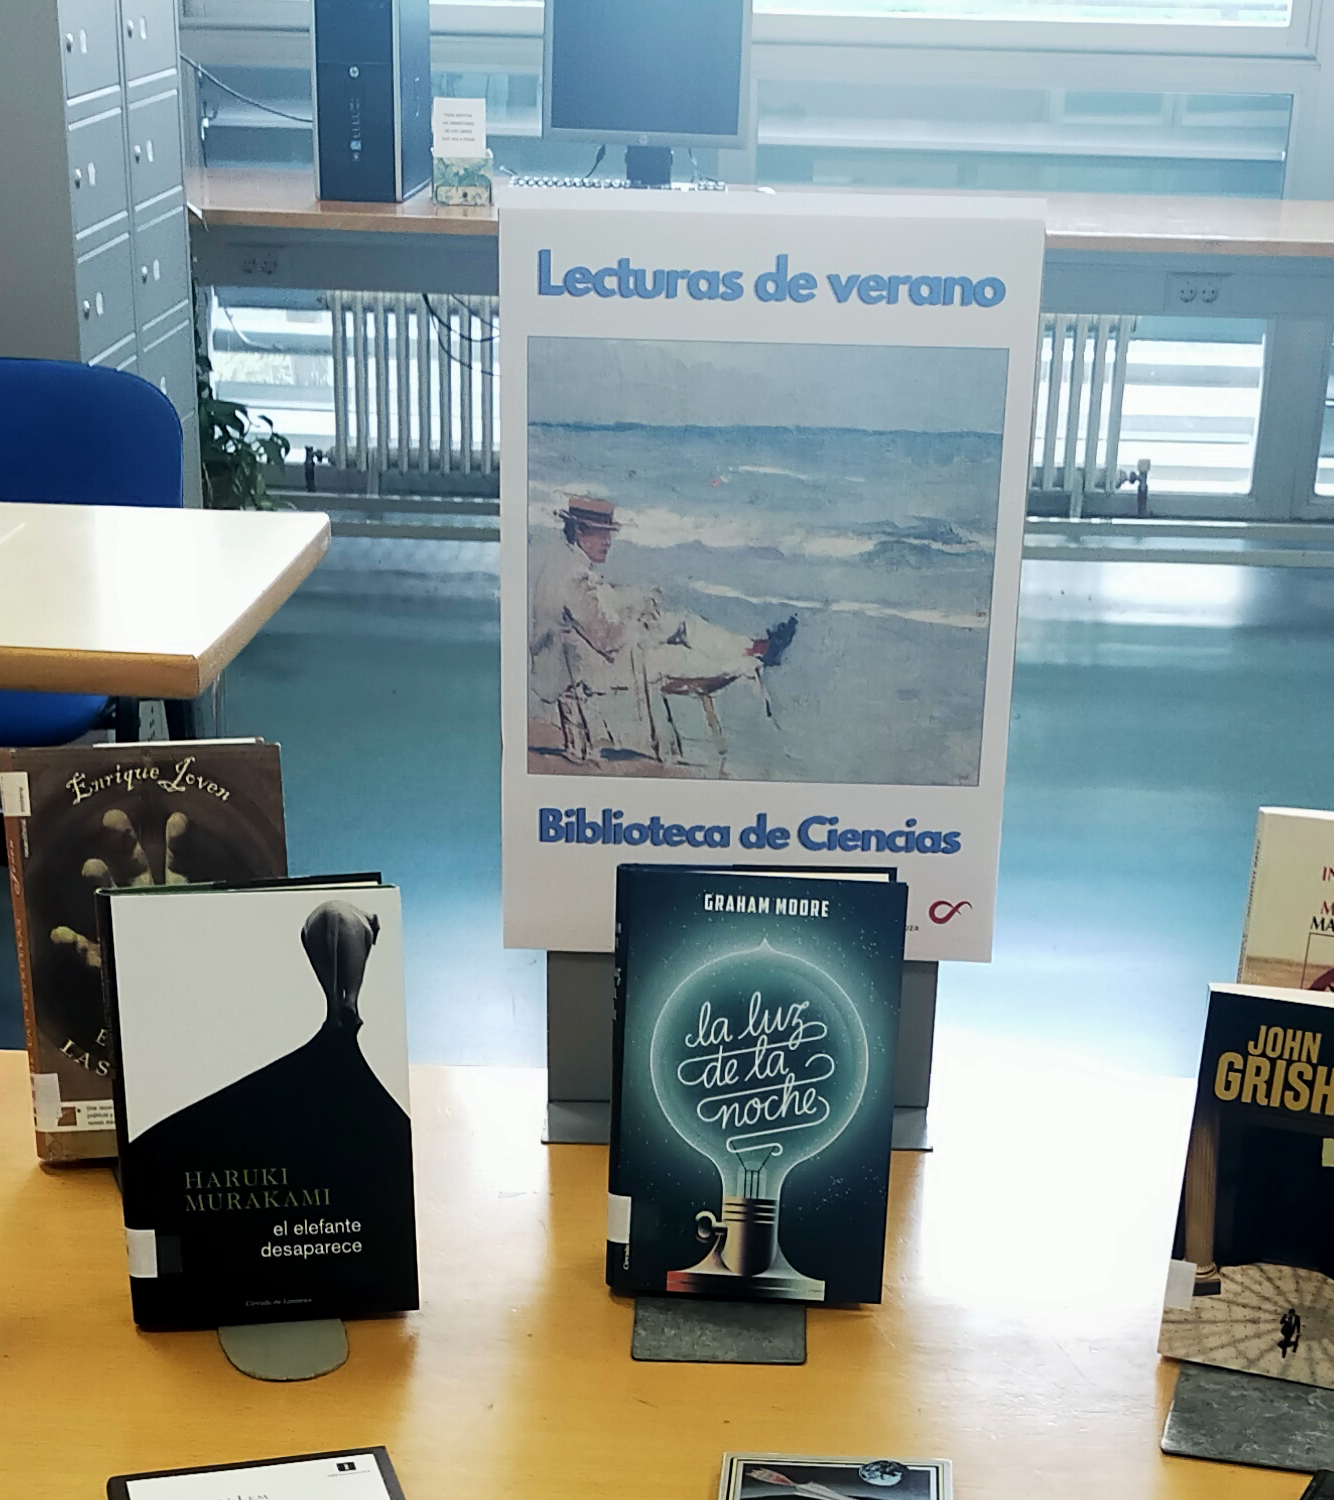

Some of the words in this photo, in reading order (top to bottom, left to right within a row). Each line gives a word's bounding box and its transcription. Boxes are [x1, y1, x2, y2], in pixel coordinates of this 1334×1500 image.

[537, 248, 744, 302] Lecturas
[753, 254, 817, 303] de
[827, 272, 1006, 308] verano
[65, 764, 160, 805] Enrique
[538, 806, 731, 850] Biblioteca
[739, 812, 790, 853] de
[796, 814, 962, 856] Ciencias
[704, 893, 769, 914] GRAHAM
[776, 896, 829, 918] MOORE
[685, 1000, 733, 1048] la
[737, 990, 815, 1048] luz
[701, 1044, 739, 1089] de
[745, 1032, 789, 1084] la
[1247, 1025, 1322, 1065] JOHN
[717, 1073, 820, 1130] noche
[185, 1168, 289, 1190] HARUKI
[185, 1188, 332, 1212] MURAKAMI
[273, 1220, 288, 1237] el
[293, 1218, 362, 1236] elefante
[261, 1241, 363, 1260] desaparece
